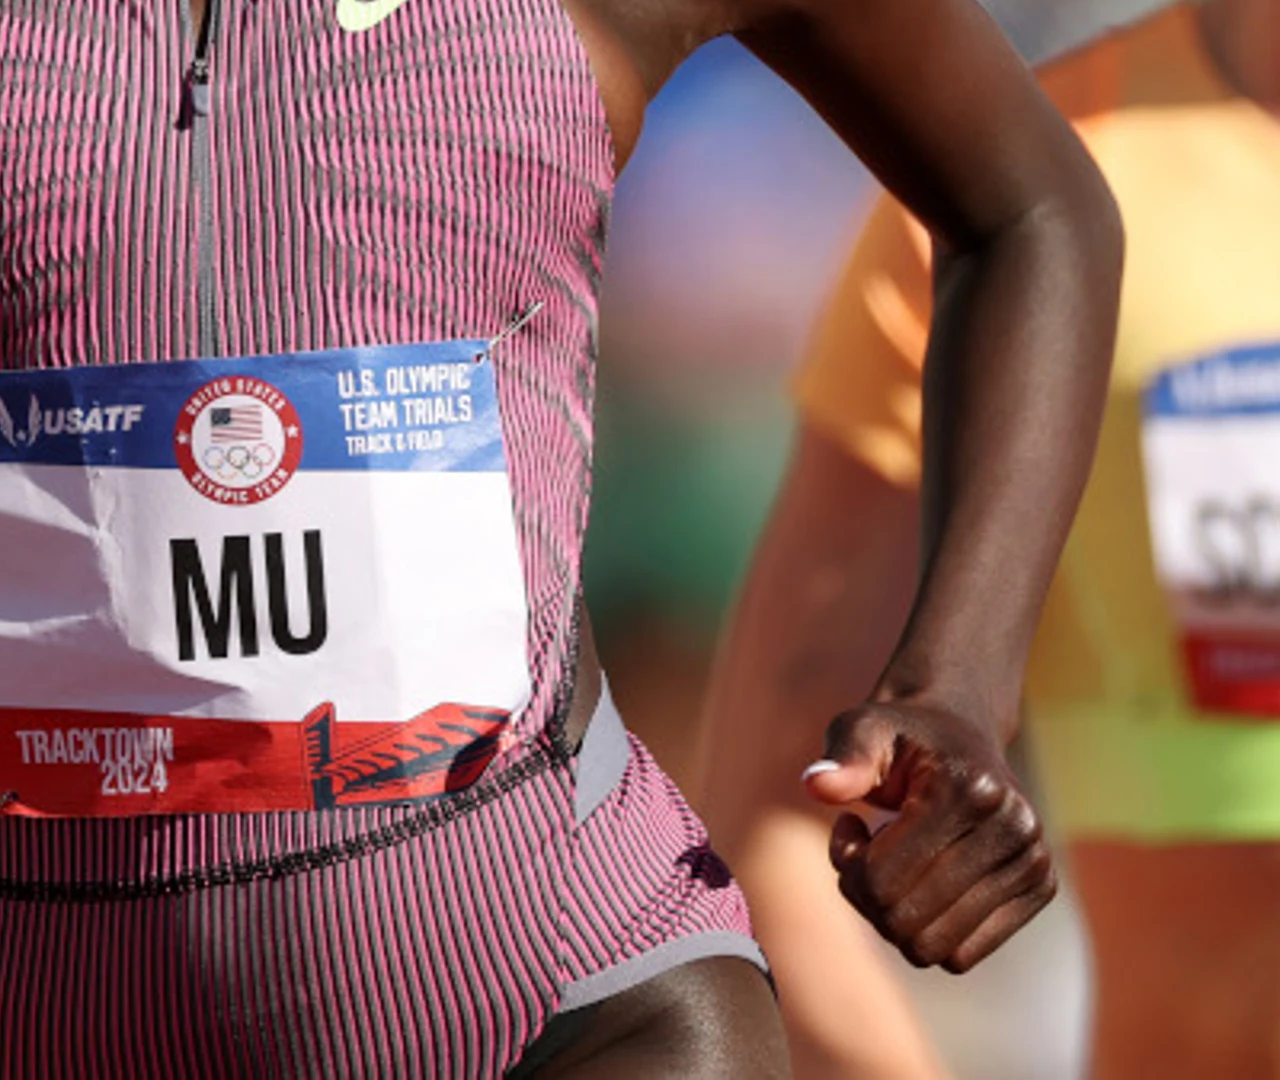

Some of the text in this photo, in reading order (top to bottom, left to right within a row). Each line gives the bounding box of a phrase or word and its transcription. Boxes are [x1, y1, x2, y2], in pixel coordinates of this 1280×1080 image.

[338, 363, 471, 399] U.S. OLYMPIC
[44, 404, 145, 435] USATF
[339, 394, 472, 431] TEAM TRIALS
[345, 433, 393, 456] TRACK
[169, 529, 328, 661] MU
[15, 727, 174, 765] TRACKTOWN
[101, 758, 168, 796] 2024
